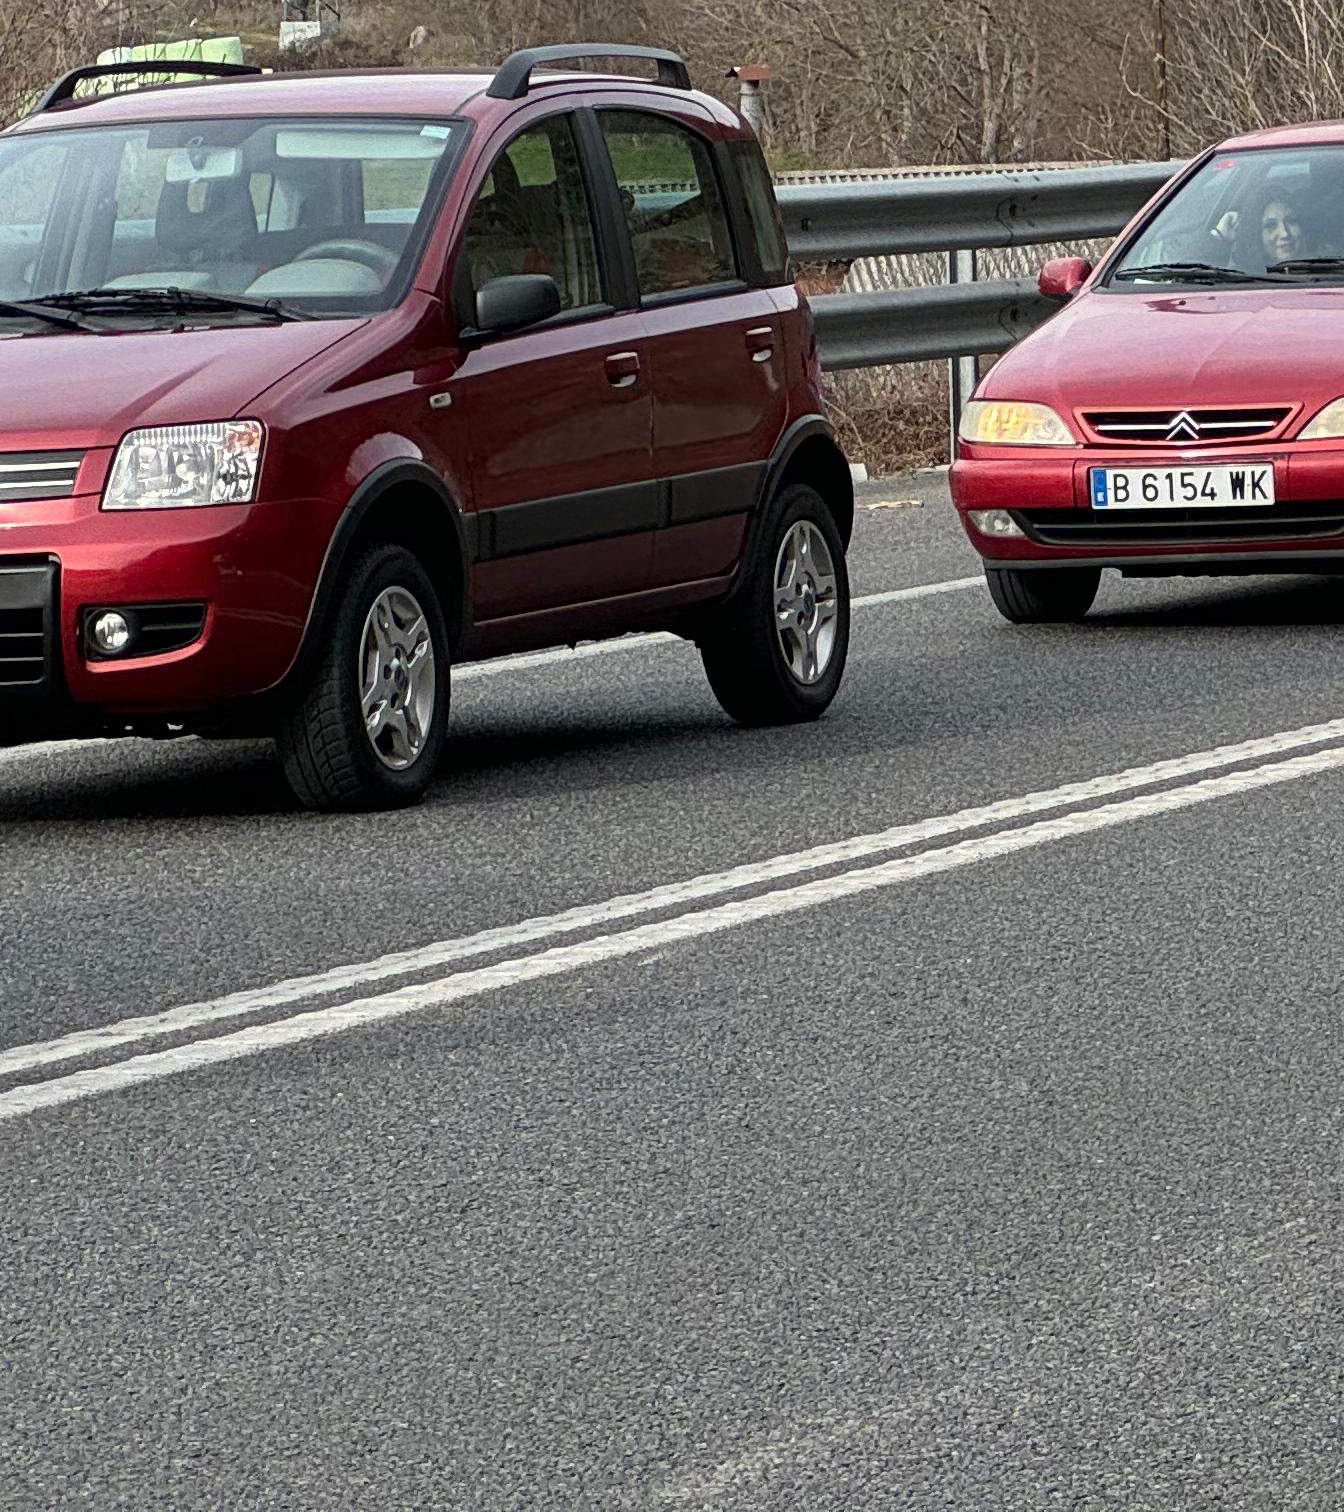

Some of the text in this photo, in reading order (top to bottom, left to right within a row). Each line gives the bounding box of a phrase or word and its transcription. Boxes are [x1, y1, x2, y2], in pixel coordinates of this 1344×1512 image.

[1113, 470, 1269, 503] B 6154 WK
